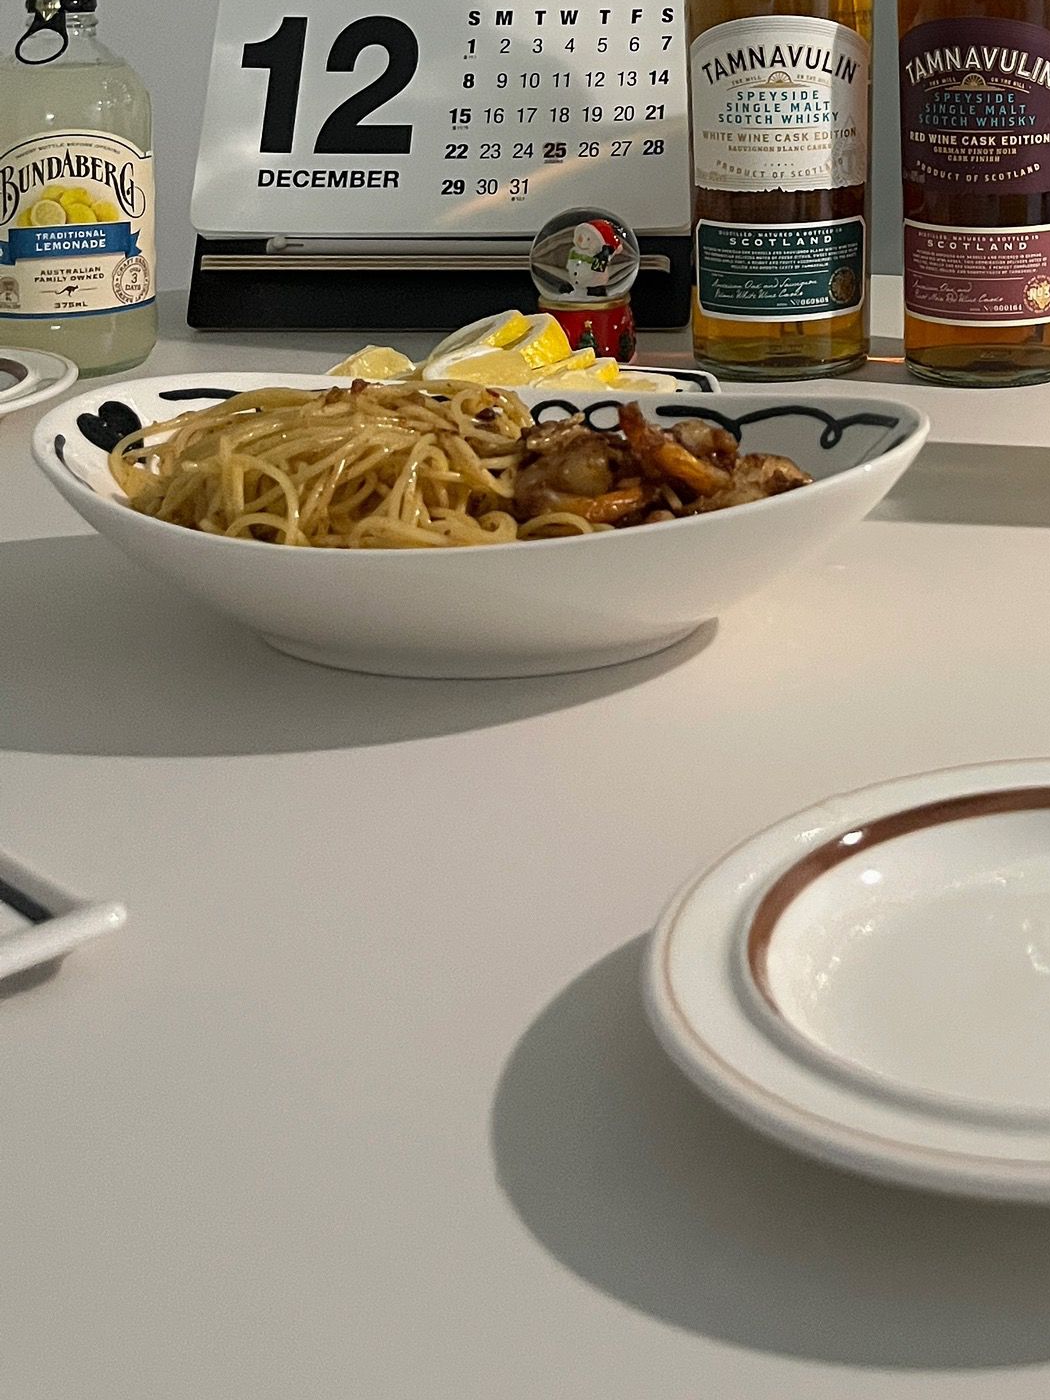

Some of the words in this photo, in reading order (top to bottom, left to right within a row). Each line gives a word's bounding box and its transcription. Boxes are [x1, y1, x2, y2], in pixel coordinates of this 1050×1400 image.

[469, 11, 480, 25] S
[496, 11, 513, 25] M
[535, 11, 546, 25] T
[560, 10, 578, 25] W
[600, 10, 610, 24] T
[632, 9, 642, 23] F
[662, 8, 673, 22] S
[468, 39, 475, 53] 1
[500, 39, 510, 53] 2
[533, 39, 542, 53] 3
[565, 38, 574, 52] 4
[598, 38, 607, 52] 5
[630, 37, 639, 51] 6
[662, 36, 672, 50] 7
[702, 45, 858, 84] TAMNAVULIN
[242, 16, 418, 154] 12
[463, 74, 474, 88] 8
[497, 73, 507, 88] 9
[521, 73, 539, 88] 10
[553, 73, 569, 87] 11
[586, 72, 604, 87] 12
[618, 71, 636, 86] 13
[649, 70, 668, 85] 14
[737, 90, 819, 101] SPEYSIDE
[934, 91, 1015, 103] SPEYSIDE
[726, 102, 781, 113] SINGLE
[791, 101, 830, 112] MALT
[925, 103, 976, 115] SINGLE
[985, 104, 1026, 115] MALT
[450, 109, 471, 123] 15
[484, 108, 504, 123] 16
[518, 108, 537, 122] 17
[550, 108, 569, 122] 18
[583, 107, 602, 122] 19
[614, 106, 634, 121] 20
[646, 105, 664, 120] 21
[718, 113, 773, 125] SCOTCH
[781, 112, 839, 124] WHISKY
[919, 114, 967, 126] SCOTCH
[976, 115, 1036, 127] WHISKY
[702, 130, 733, 142] WHITE
[737, 133, 769, 142] WINE
[775, 133, 808, 142] CASK
[814, 128, 857, 140] EDITION
[910, 130, 926, 142] RED
[928, 133, 958, 145] WINE
[961, 135, 996, 146] CASK
[1001, 133, 1050, 145] EDITION
[445, 144, 468, 159] 22
[480, 144, 500, 159] 23
[513, 143, 533, 158] 24
[544, 143, 566, 158] 25
[578, 142, 599, 157] 26
[611, 141, 632, 156] 27
[643, 140, 664, 155] 28
[716, 159, 765, 178] PRODUCT
[772, 171, 785, 179] OF
[916, 160, 960, 181] PRODUCT
[966, 174, 979, 182] OF
[984, 163, 1041, 182] SCOTLAND
[258, 170, 399, 188] DECEMBER
[441, 180, 465, 195] 29
[476, 179, 497, 195] 30
[510, 179, 528, 194] 31
[35, 229, 106, 241] TRADITIONAL
[729, 235, 833, 246] SCOTLAND
[35, 239, 106, 252] LEMONADE
[927, 239, 1028, 251] SCOTLAND
[34, 275, 67, 283] FAMILY
[70, 272, 105, 281] OWNED
[40, 266, 101, 276] AUSTRALIAN
[131, 272, 138, 284] 3
